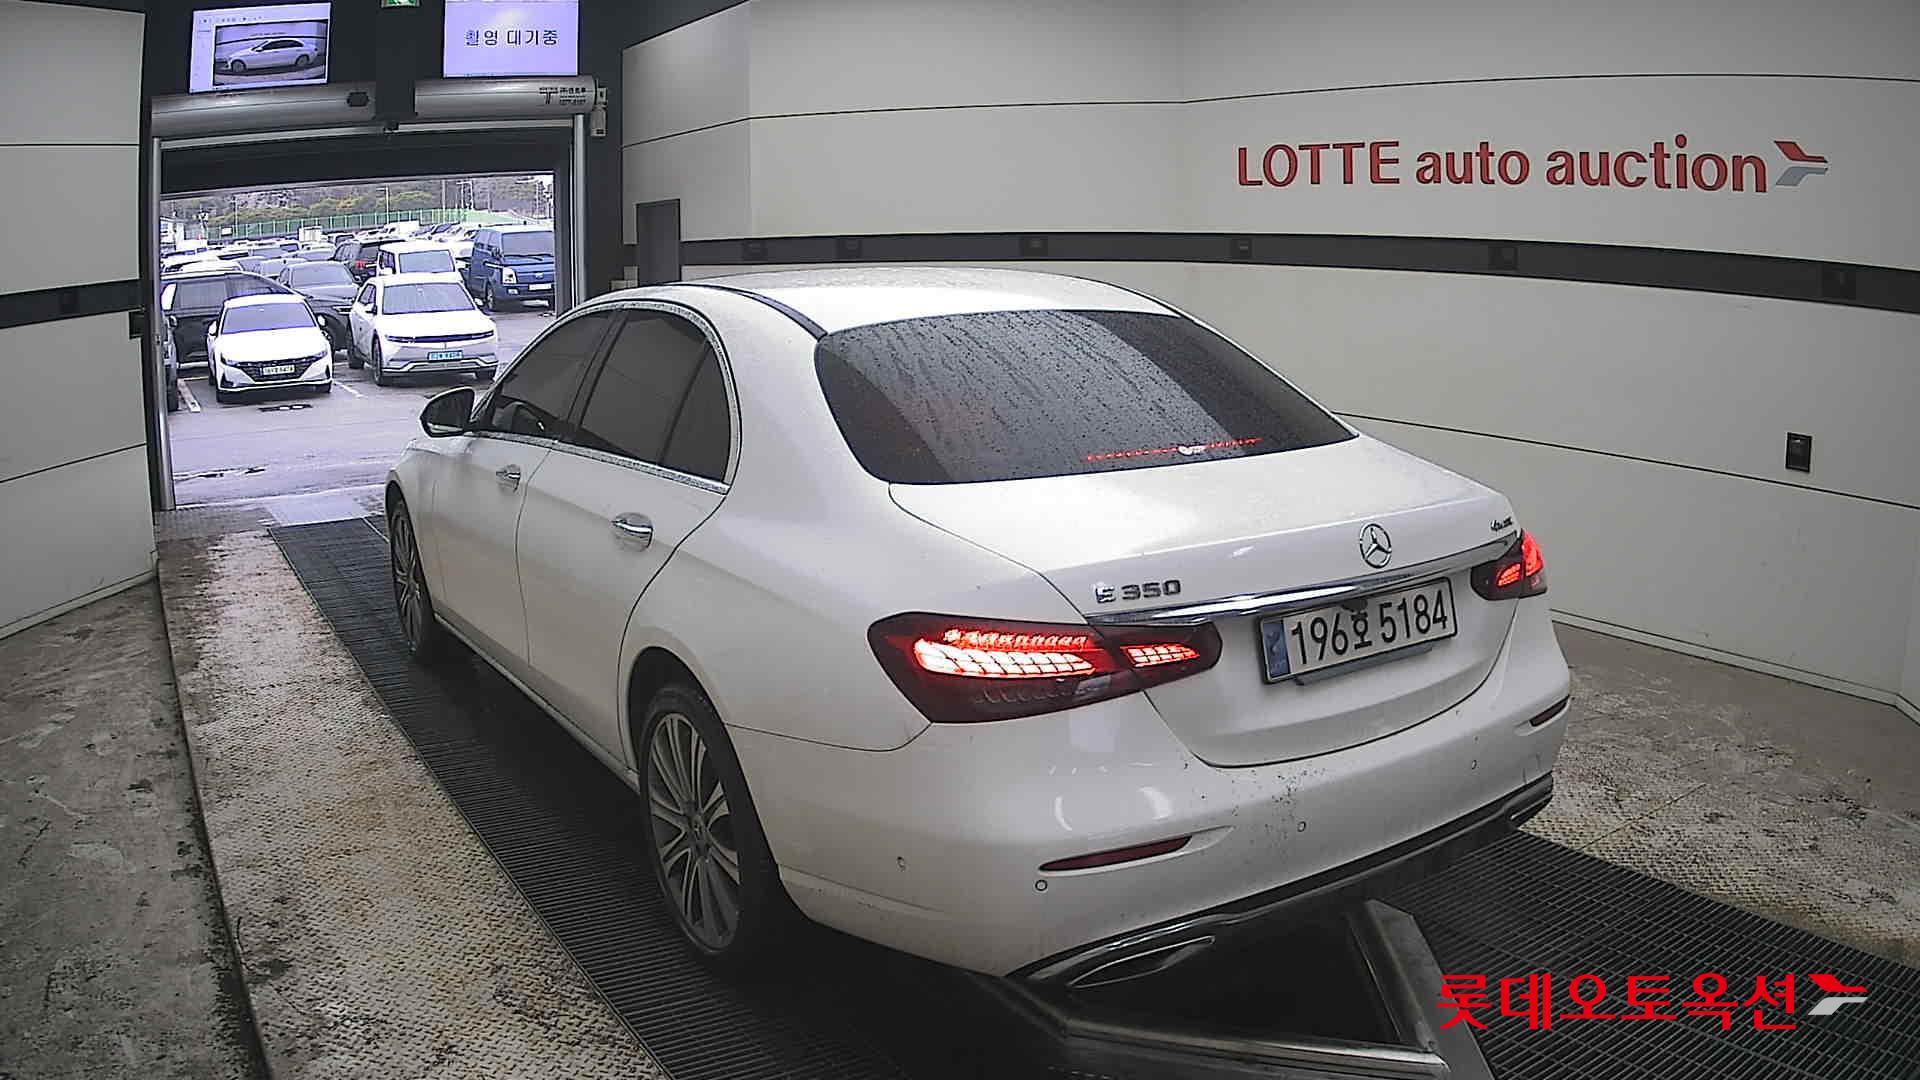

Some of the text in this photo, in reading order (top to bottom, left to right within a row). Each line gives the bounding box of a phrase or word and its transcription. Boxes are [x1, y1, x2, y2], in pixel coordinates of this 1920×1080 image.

[507, 29, 559, 46] 대기중
[1237, 134, 1768, 193] LOTTE auto auction
[1095, 579, 1181, 604] E 350
[1291, 589, 1449, 665] 196호 5184
